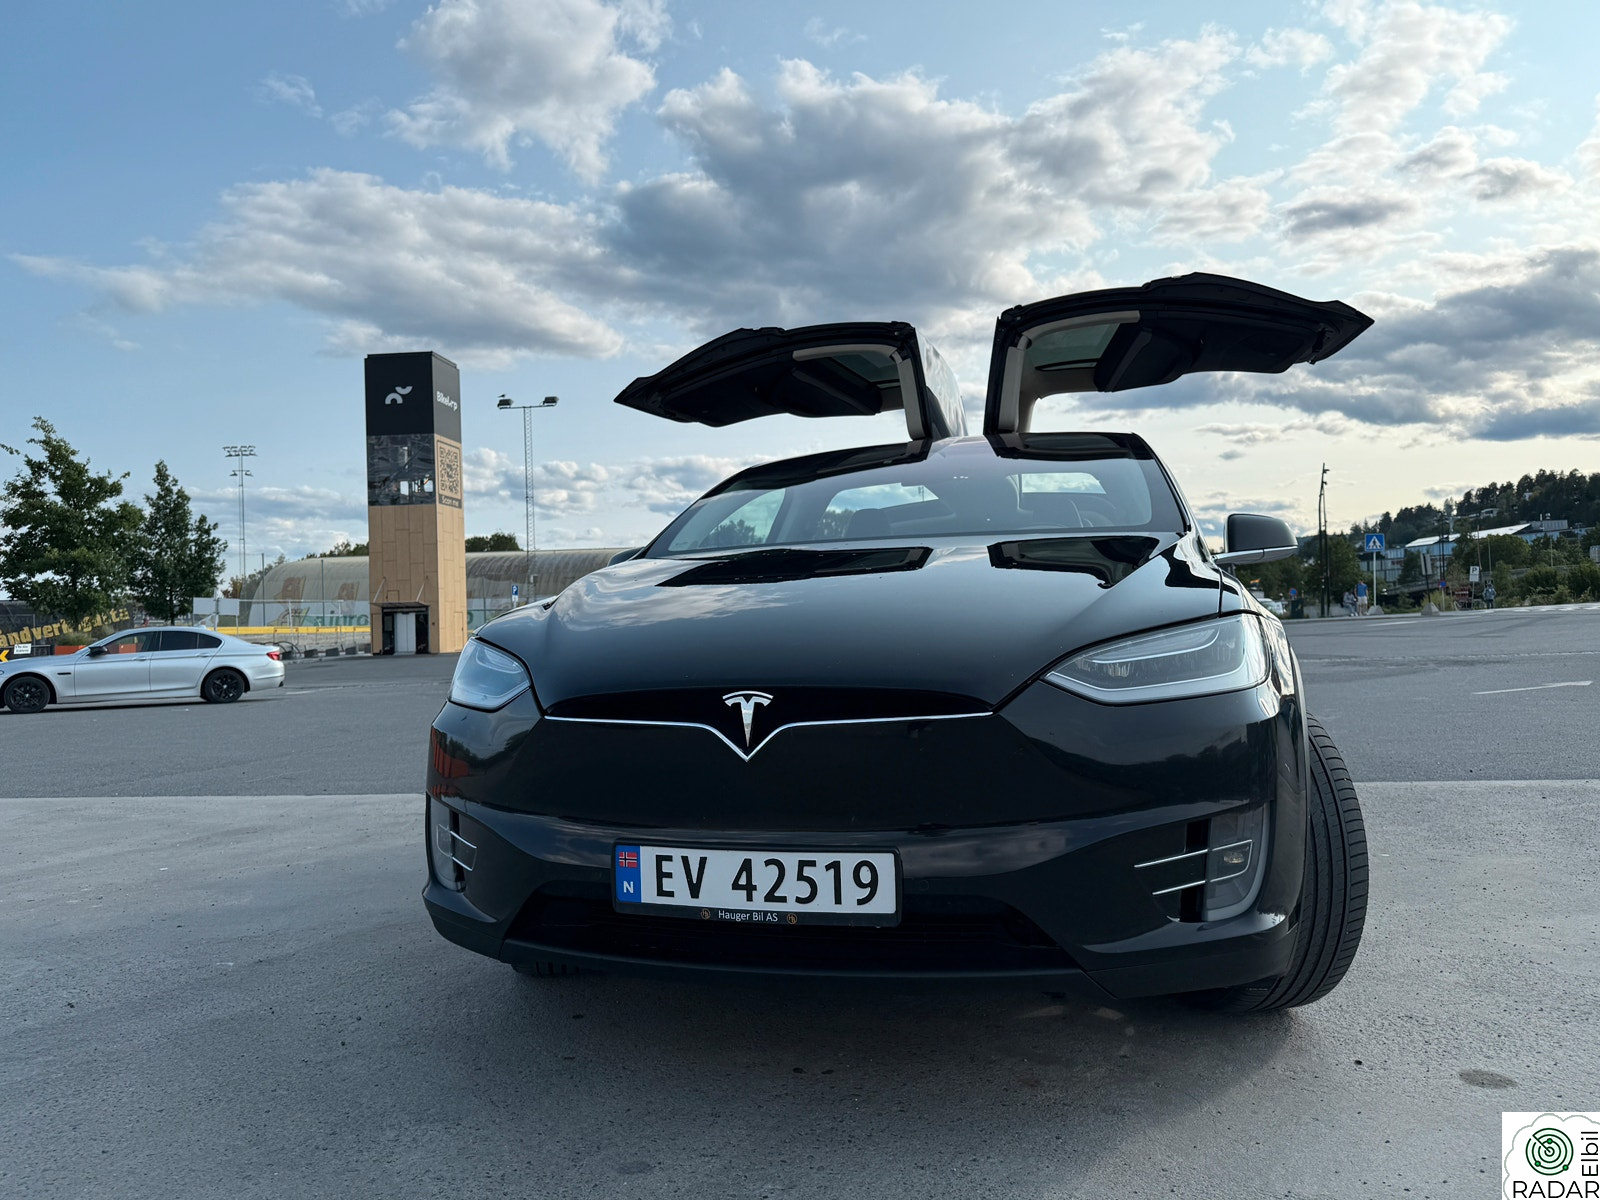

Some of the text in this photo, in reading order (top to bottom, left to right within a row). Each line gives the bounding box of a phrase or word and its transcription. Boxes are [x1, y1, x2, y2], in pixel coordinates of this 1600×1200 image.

[623, 880, 634, 893] N
[655, 854, 879, 906] EV 42519
[718, 910, 778, 922] Hauger Bil AS
